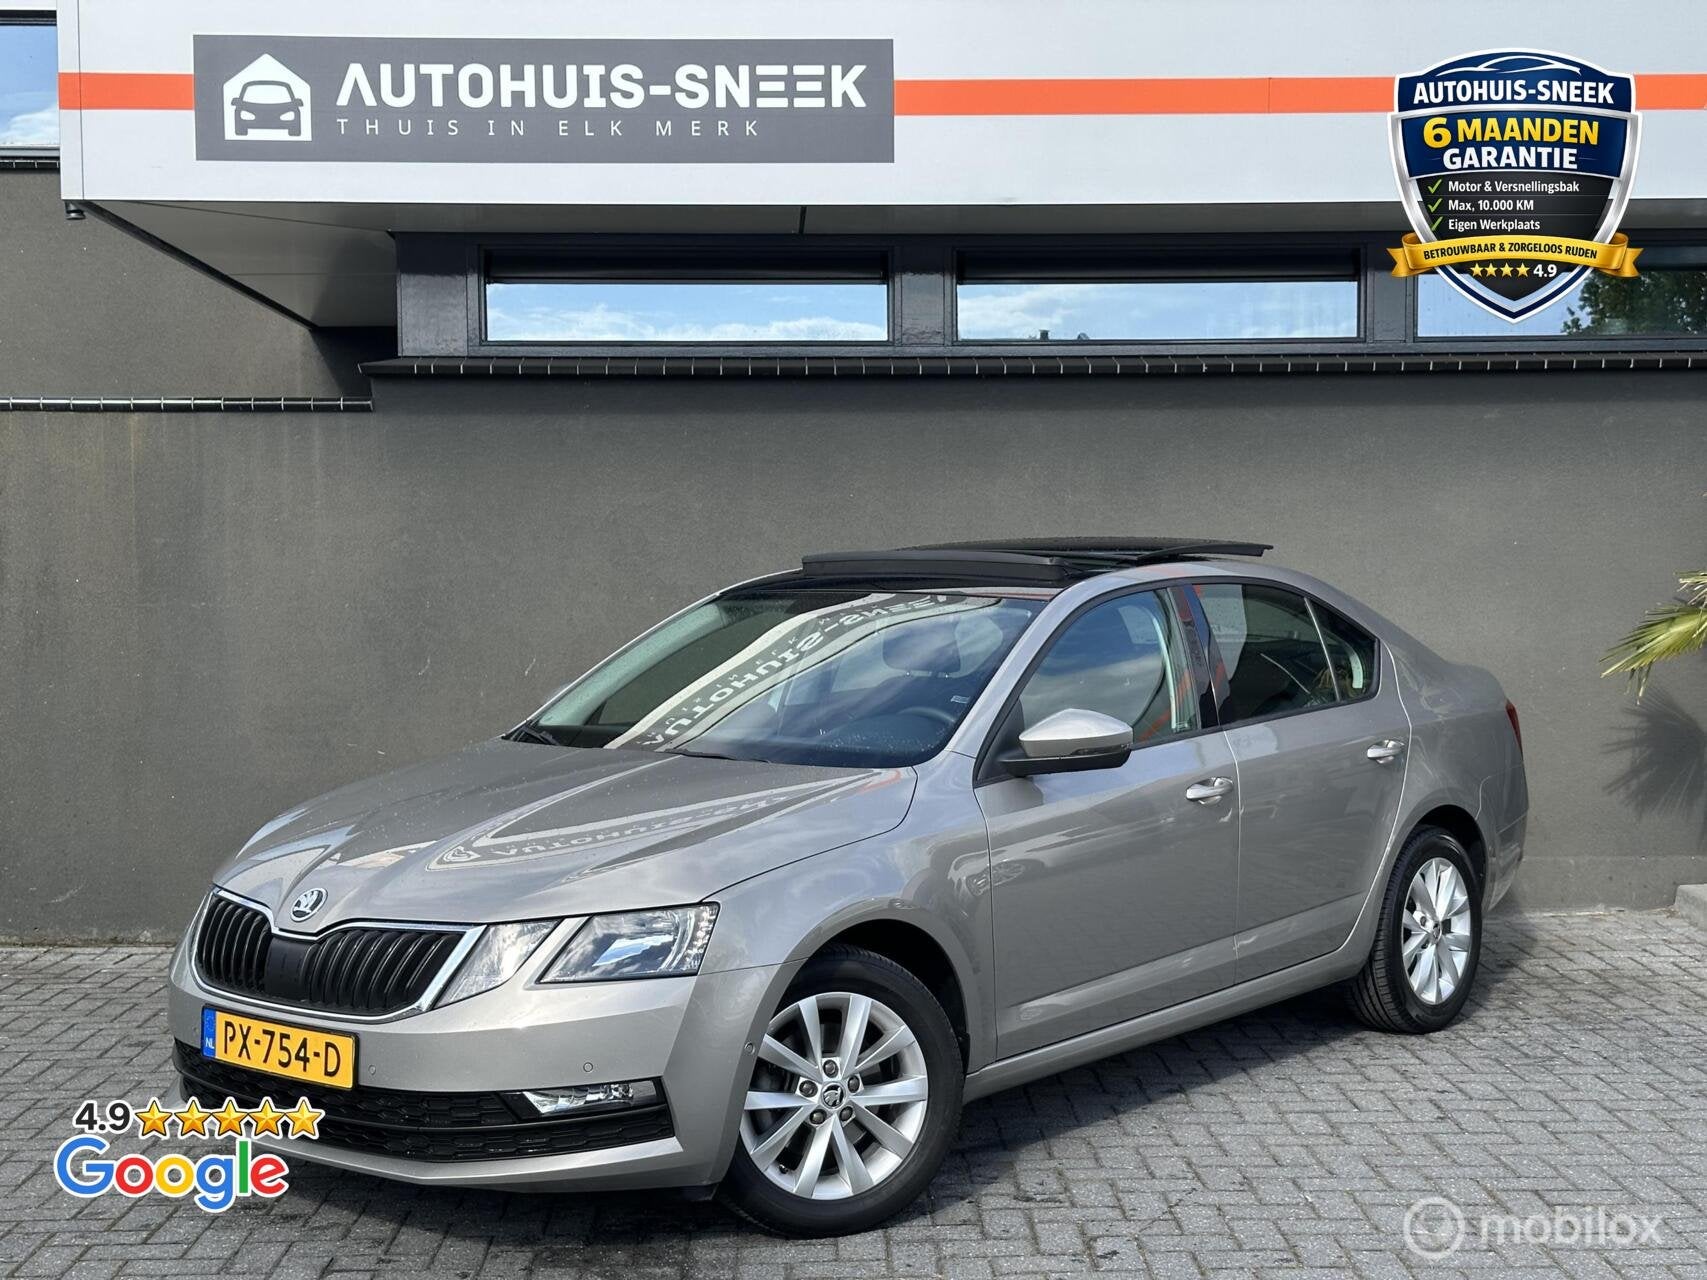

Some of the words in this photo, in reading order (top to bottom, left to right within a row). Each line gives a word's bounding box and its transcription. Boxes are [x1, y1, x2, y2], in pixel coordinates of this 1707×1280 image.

[336, 63, 867, 109] AUTOHUIS-SNEEK
[336, 118, 460, 136] THUIS
[488, 120, 526, 136] IN
[559, 121, 623, 137] ELK
[656, 121, 760, 137] MERK
[205, 1037, 215, 1049] NL
[223, 1020, 341, 1077] PX-754-D
